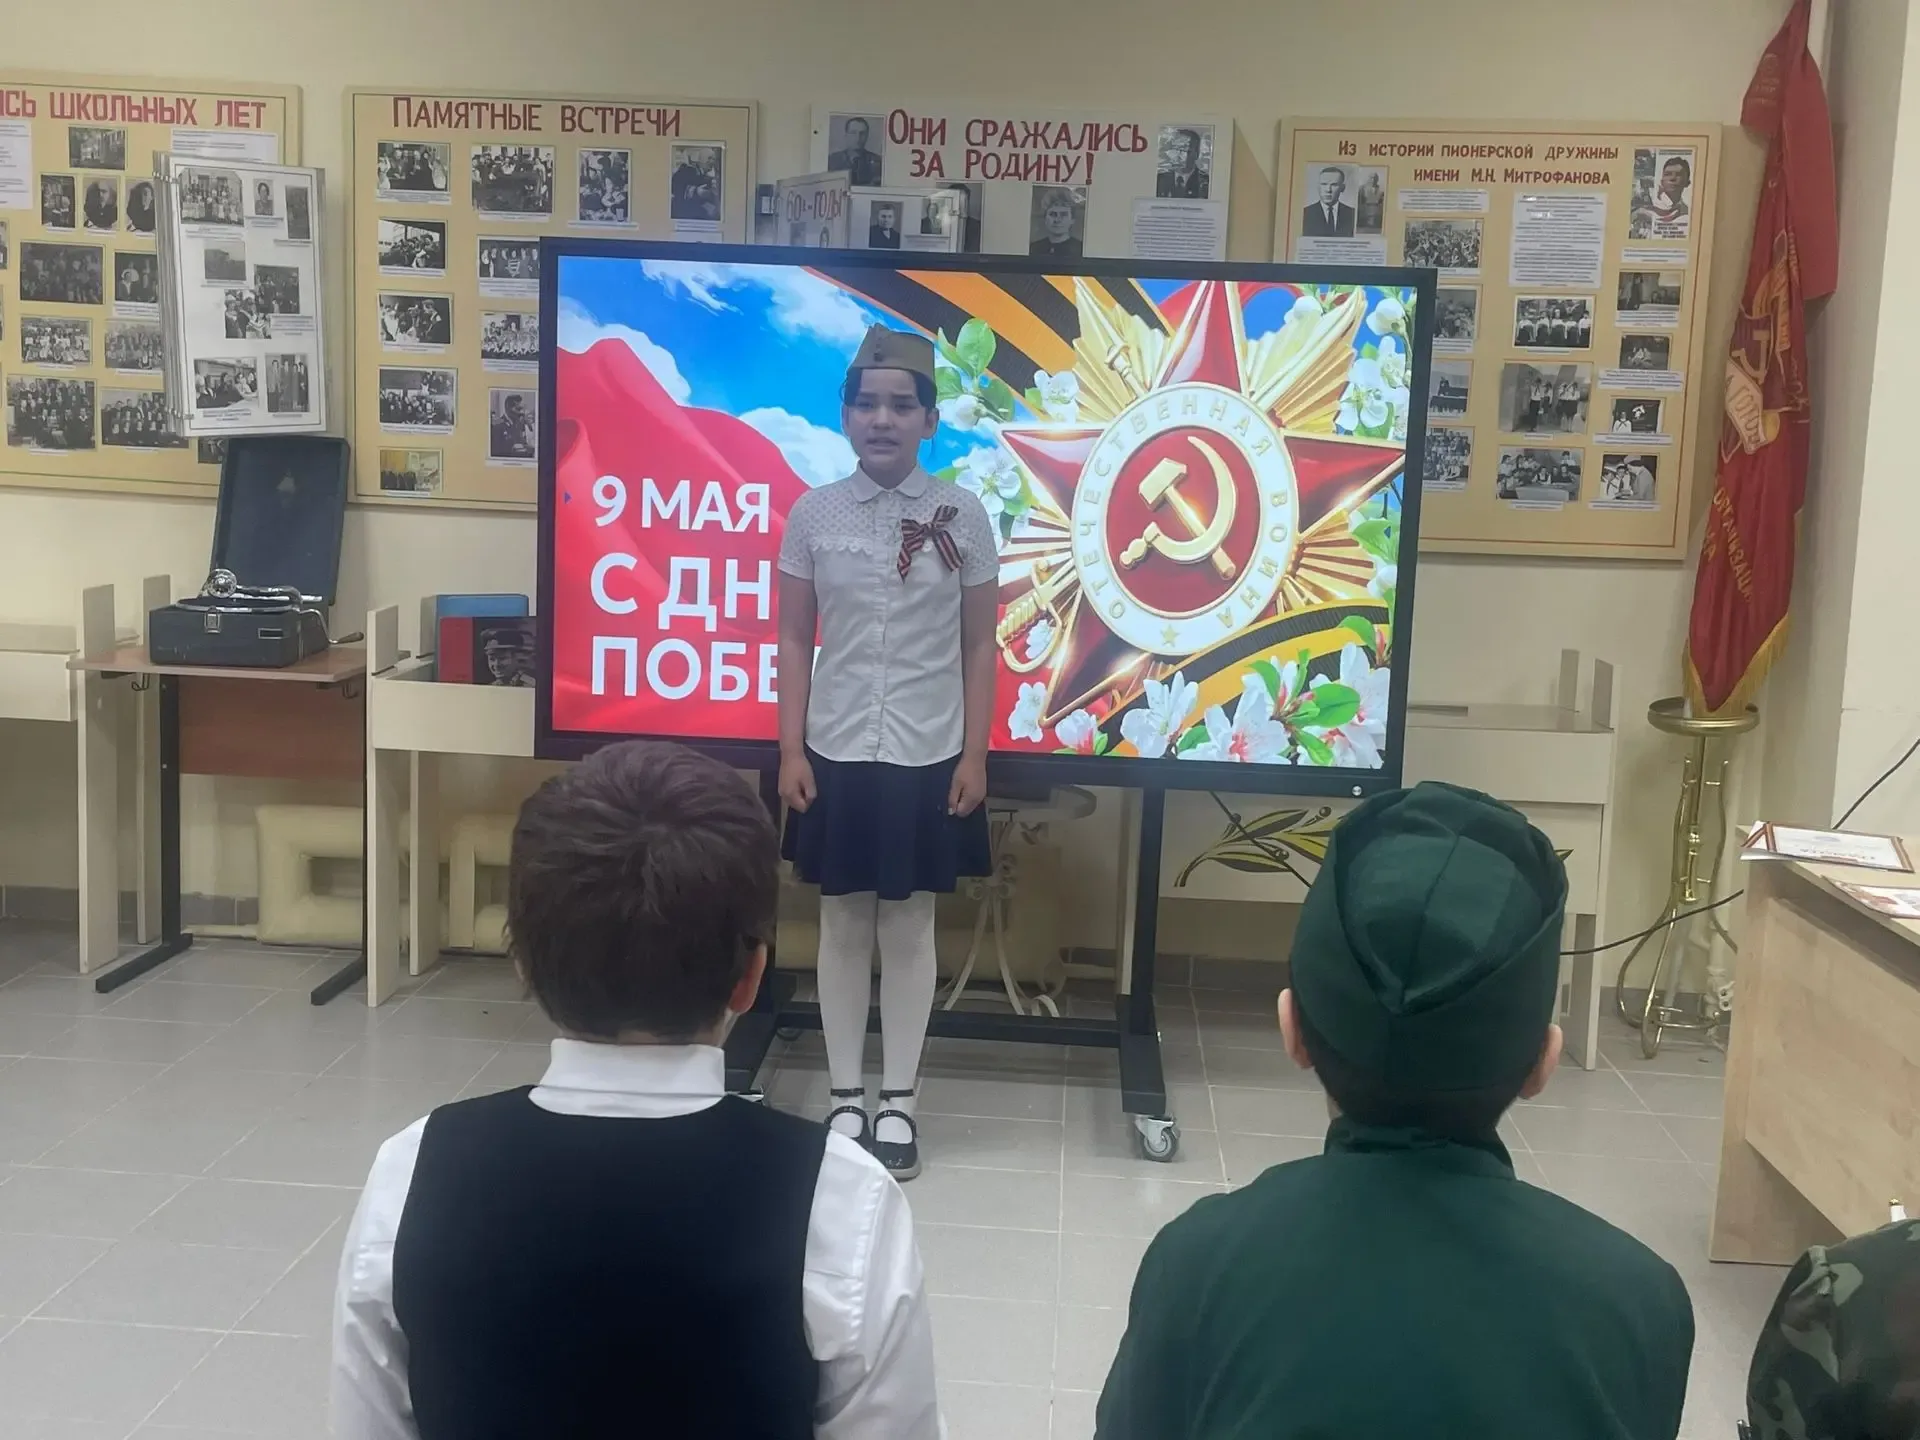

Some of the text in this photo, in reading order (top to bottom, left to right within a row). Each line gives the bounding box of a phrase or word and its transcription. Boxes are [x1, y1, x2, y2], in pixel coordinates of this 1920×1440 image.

[50, 91, 198, 126] ШКОЛЬНЫХ
[214, 99, 267, 129] ЛЕТ
[393, 97, 681, 137] ПАМЯТНЫЕ ВСТРЕЧИ
[888, 108, 1148, 153] ОНИ СРАЖАЛИСЬ
[910, 149, 1094, 185] ЗА РОДИНУ!
[1369, 143, 1435, 157] ИСТОРИИ
[1441, 144, 1534, 159] ПИОНЕРСКОЙ
[1544, 146, 1619, 161] ДРУЖИНЫ
[1413, 168, 1460, 182] ИМЕНИ
[1503, 168, 1611, 185] МИТРОФАНОВА
[592, 475, 770, 533] 9 МАЯ
[590, 552, 772, 632] С ДН
[591, 635, 779, 703] ПОБЕ
